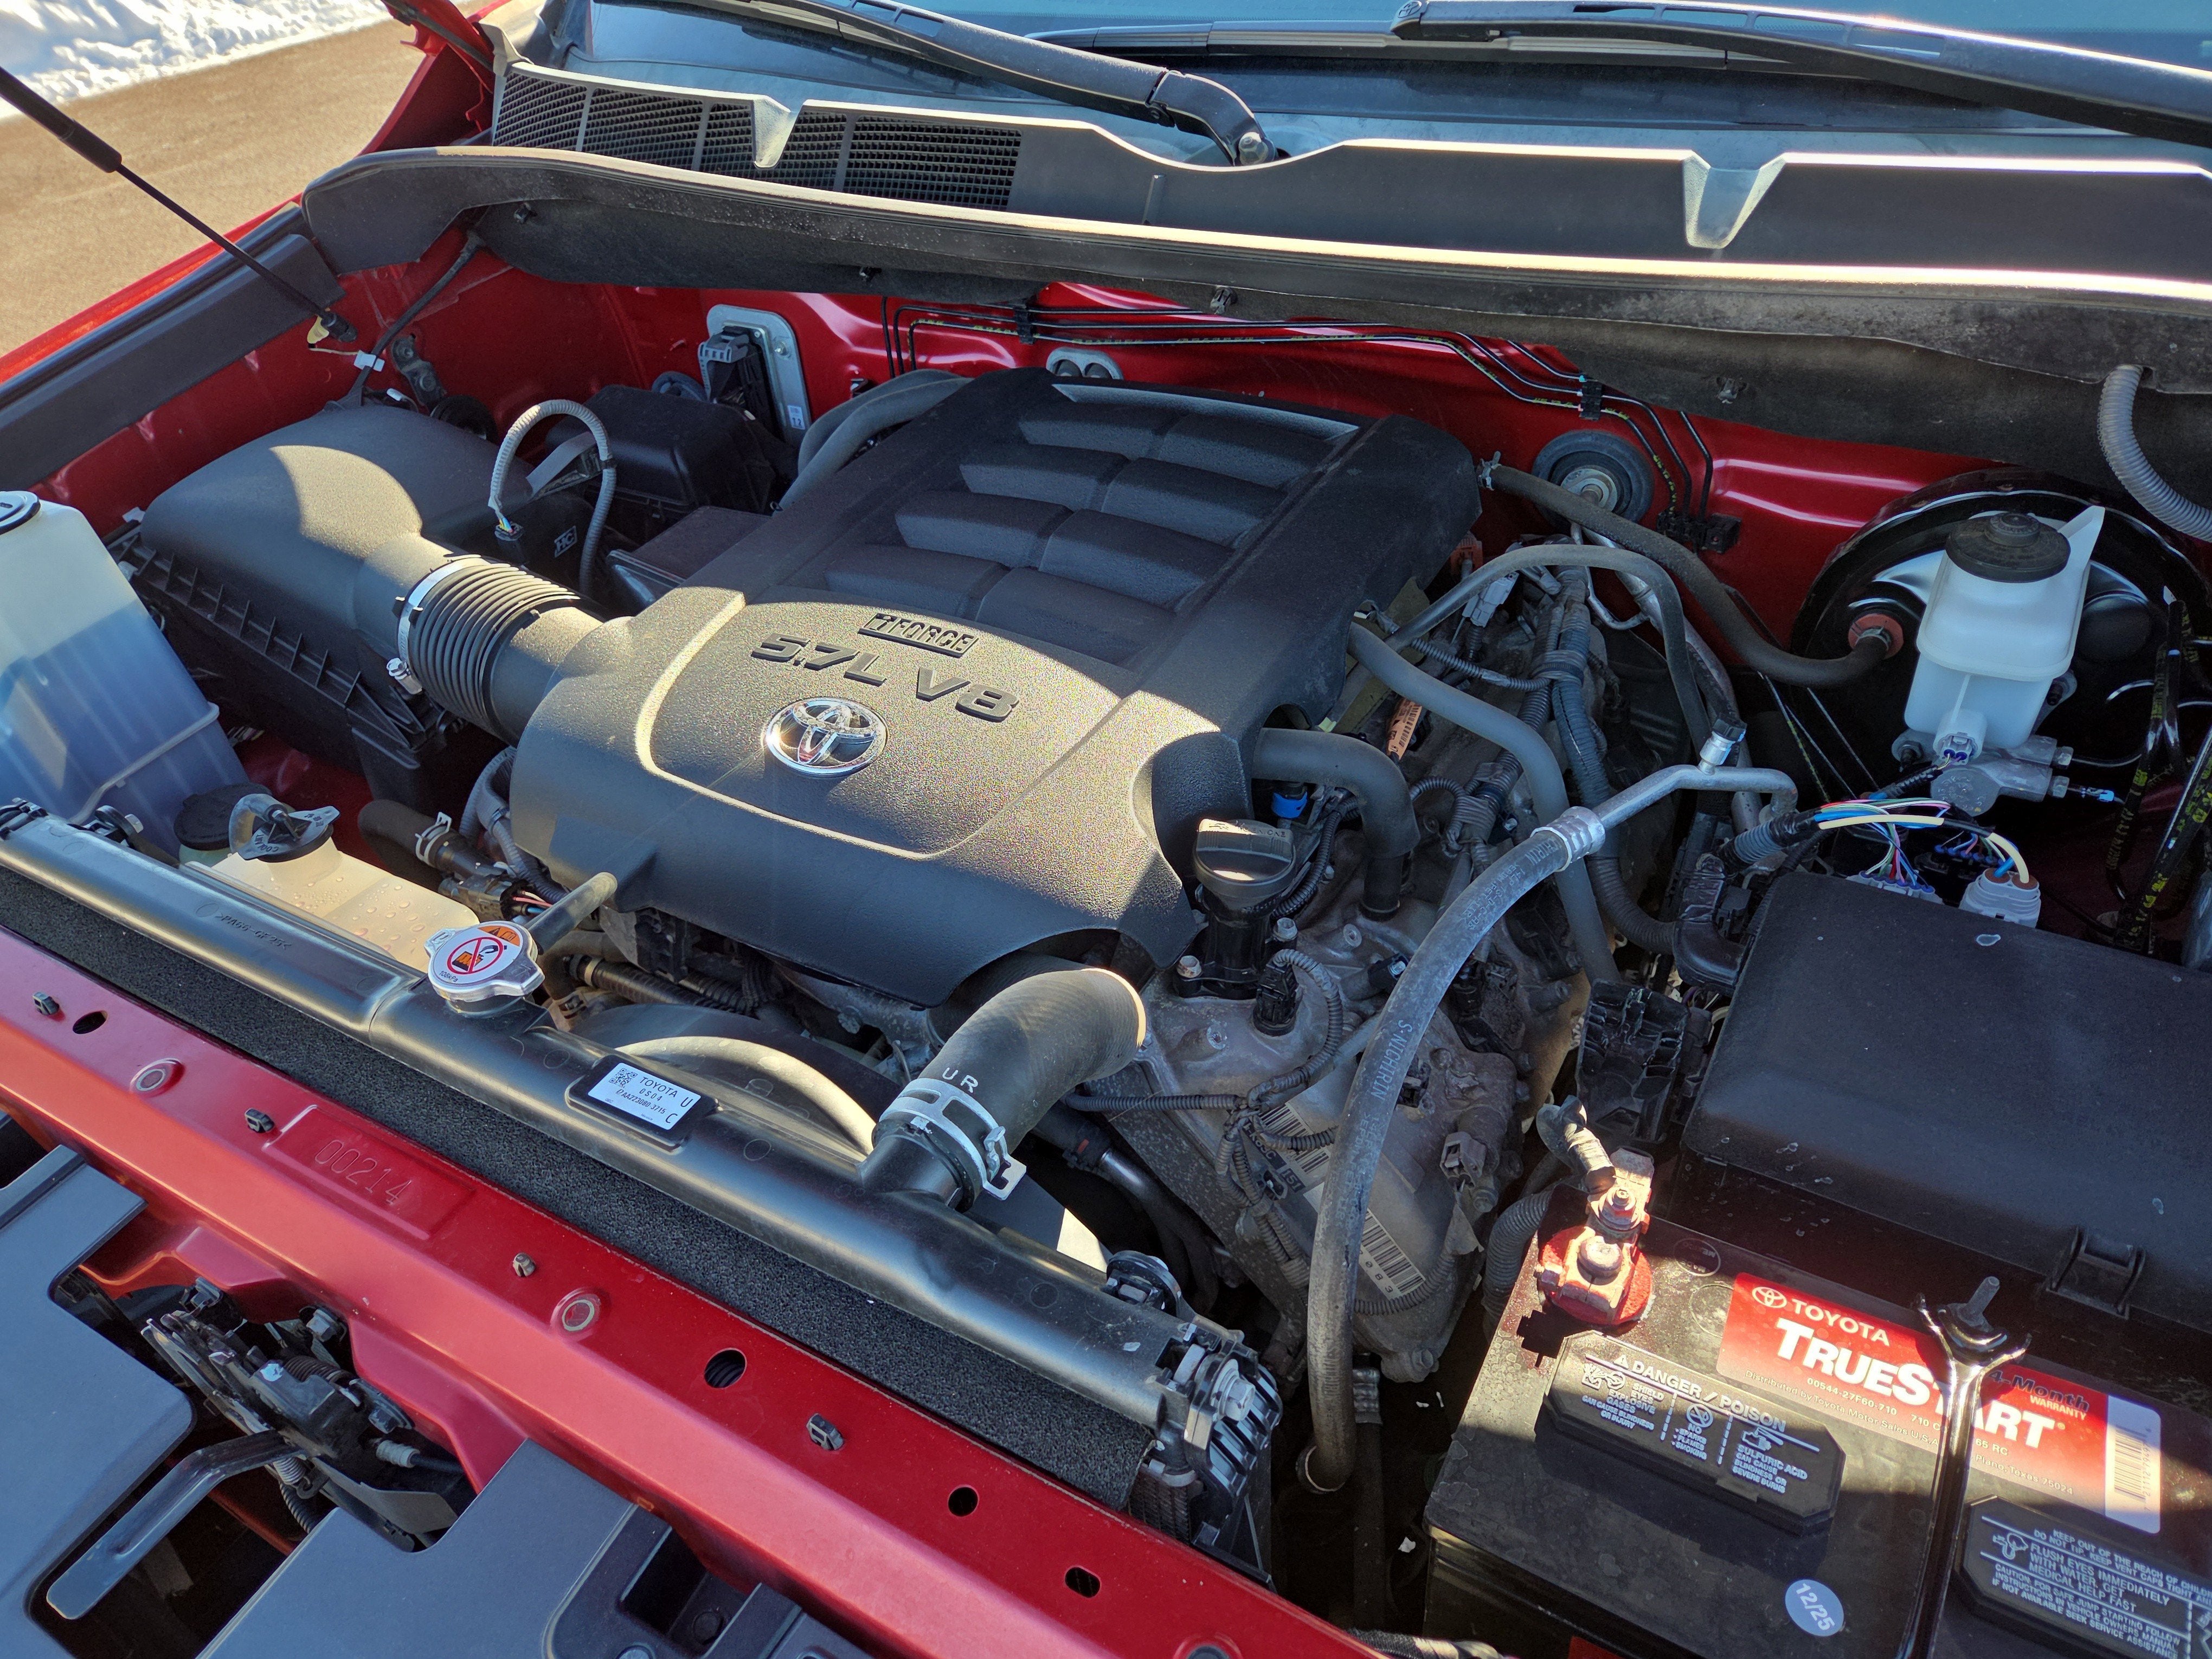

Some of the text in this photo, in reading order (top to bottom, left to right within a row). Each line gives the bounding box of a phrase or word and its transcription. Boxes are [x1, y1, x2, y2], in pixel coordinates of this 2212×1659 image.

[751, 632, 1020, 722] 5.7L V8
[639, 1076, 679, 1098] TOYOTA
[665, 1113, 678, 1124] C
[315, 1139, 413, 1205] 00214
[1791, 1298, 1891, 1347] TOYOTA
[1606, 1396, 1636, 1414] GASES
[1608, 1388, 1656, 1414] EXPLOSIVE
[1630, 1390, 1654, 1405] EYES
[1632, 1382, 1664, 1401] SHIELD
[1632, 1360, 1702, 1399] DANGER
[1719, 1394, 1787, 1433] POISON
[1776, 1316, 2056, 1450] TRUESRT
[1687, 1423, 1702, 1435] NO
[1806, 1377, 1898, 1416] 00544-27F60-710
[1910, 1414, 1929, 1427] 710
[1991, 1443, 2009, 1456] RC
[2029, 1394, 2087, 1421] WARRANTY
[1745, 1369, 1798, 1396] Distributed
[1799, 1390, 1814, 1401] by
[1814, 1394, 1846, 1414] Toyota
[1848, 1407, 1880, 1425] Motor
[1881, 1419, 1908, 1436] Sales
[2008, 1465, 2039, 1483] Texas
[2041, 1477, 2074, 1495] 75024
[1732, 1465, 1761, 1483] SEVERE
[1734, 1458, 1787, 1487] BLINDNESS OR
[1735, 1452, 1778, 1475] CAN CAUSE
[1737, 1443, 1808, 1480] SULFURIC ACID
[2030, 1542, 2170, 1606] FLUSH EYES IMMEDIATELY
[2030, 1552, 2056, 1571] WITH
[2102, 1581, 2125, 1599] GET
[2034, 1528, 2047, 1540] DO
[2049, 1535, 2066, 1548] NOT
[2089, 1552, 2112, 1566] KEEP
[2115, 1562, 2137, 1577] VENT
[2140, 1572, 2164, 1587] CAPS
[2053, 1528, 2075, 1544] KEEP
[2077, 1539, 2096, 1553] OUT
[2098, 1548, 2111, 1558] OF
[2114, 1554, 2131, 1568] THE
[2133, 1561, 2163, 1580] REACH
[2165, 1574, 2178, 1584] OF
[1795, 1583, 1836, 1631] 12/25
[1992, 1577, 2001, 1586] IF
[2002, 1581, 2020, 1596] NOT
[2065, 1609, 2087, 1625] SEEK
[2089, 1619, 2124, 1640] SERVICE
[1995, 1571, 2053, 1602] INSTRUCTIONS
[2066, 1600, 2101, 1622] VEHICLE
[2029, 1561, 2137, 1613] MEDICAL HELP FAST
[2034, 1579, 2052, 1593] FOR
[2053, 1587, 2075, 1603] SAFE
[2076, 1597, 2100, 1612] JUMP
[2101, 1607, 2144, 1631] STARTING
[2145, 1625, 2181, 1646] FOLLOW
